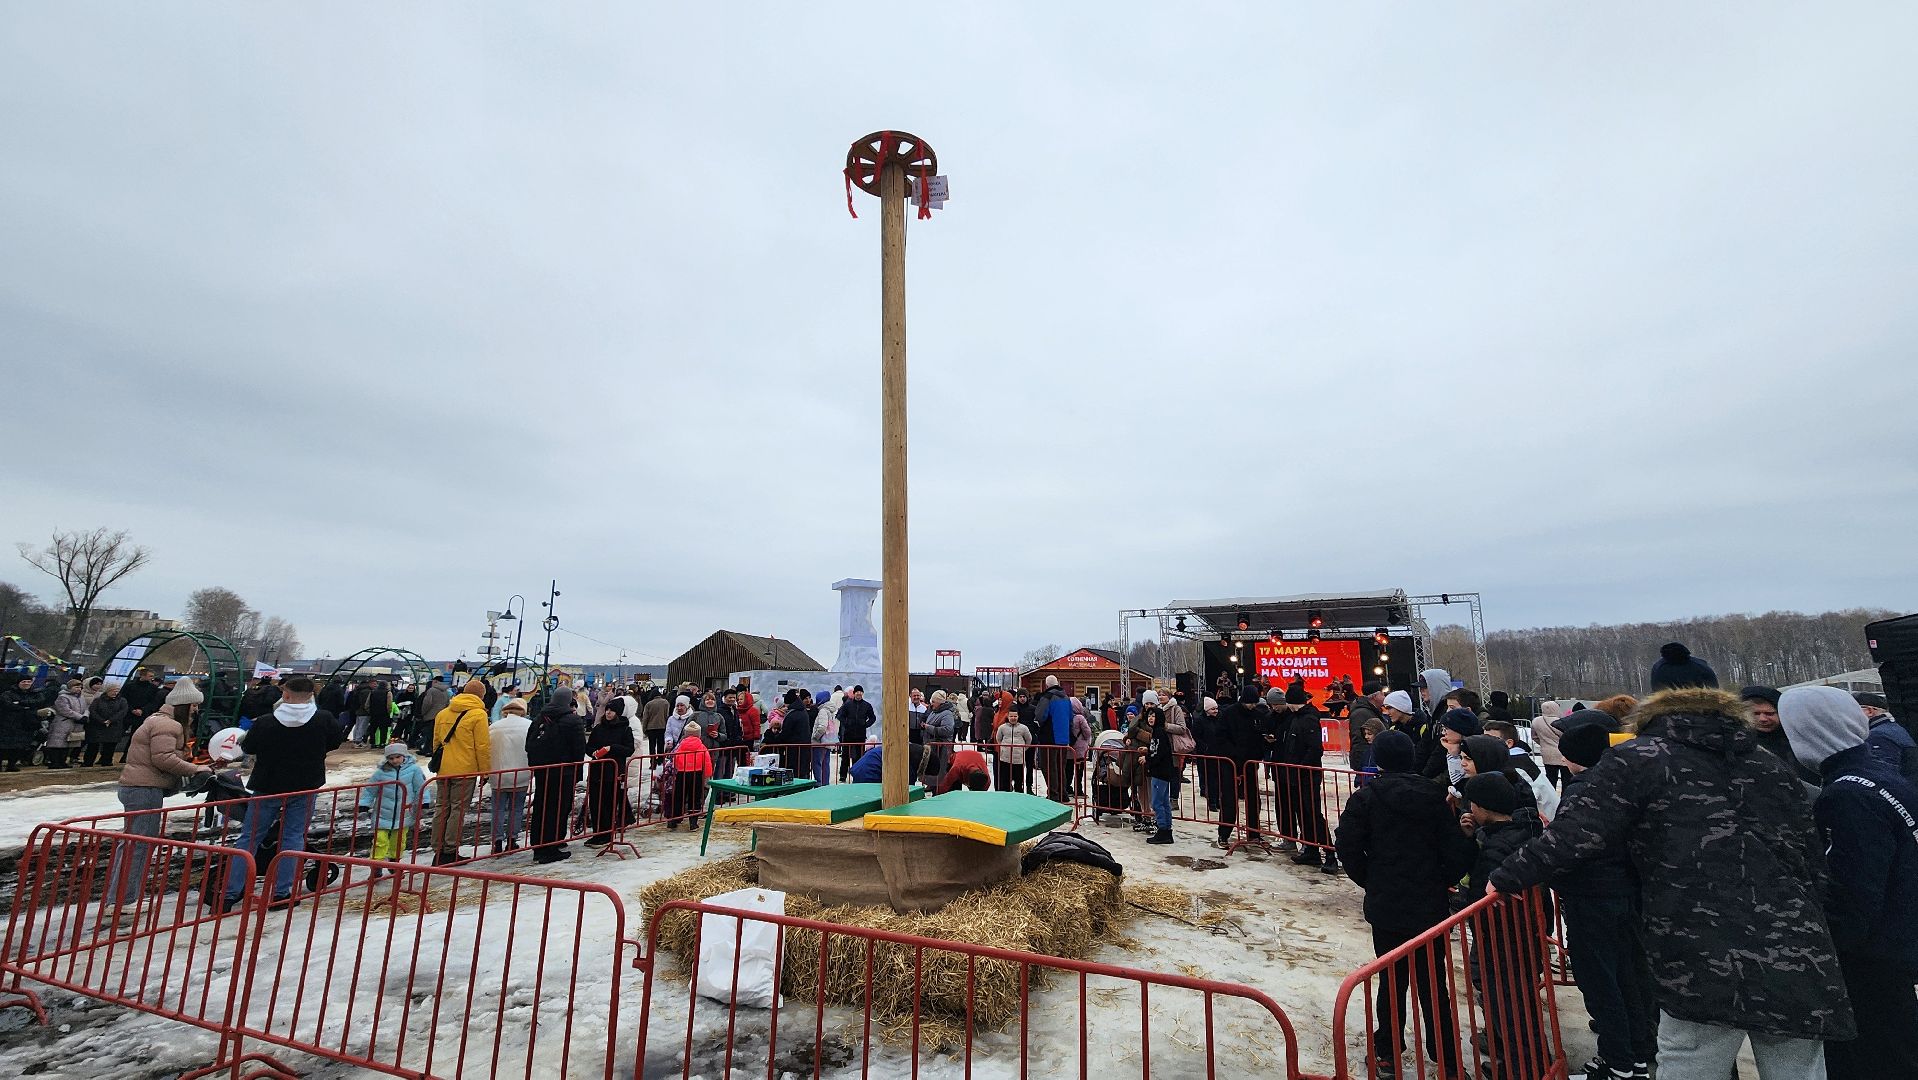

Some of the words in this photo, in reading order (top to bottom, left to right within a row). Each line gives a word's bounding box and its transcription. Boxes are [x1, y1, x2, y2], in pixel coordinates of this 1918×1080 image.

[1259, 647, 1271, 656] 17
[1274, 646, 1317, 655] МАРТА
[1261, 657, 1328, 667] ЗАХОДИТЕ
[1261, 668, 1279, 677] НА
[1879, 788, 1916, 827] UNAFFECTED
